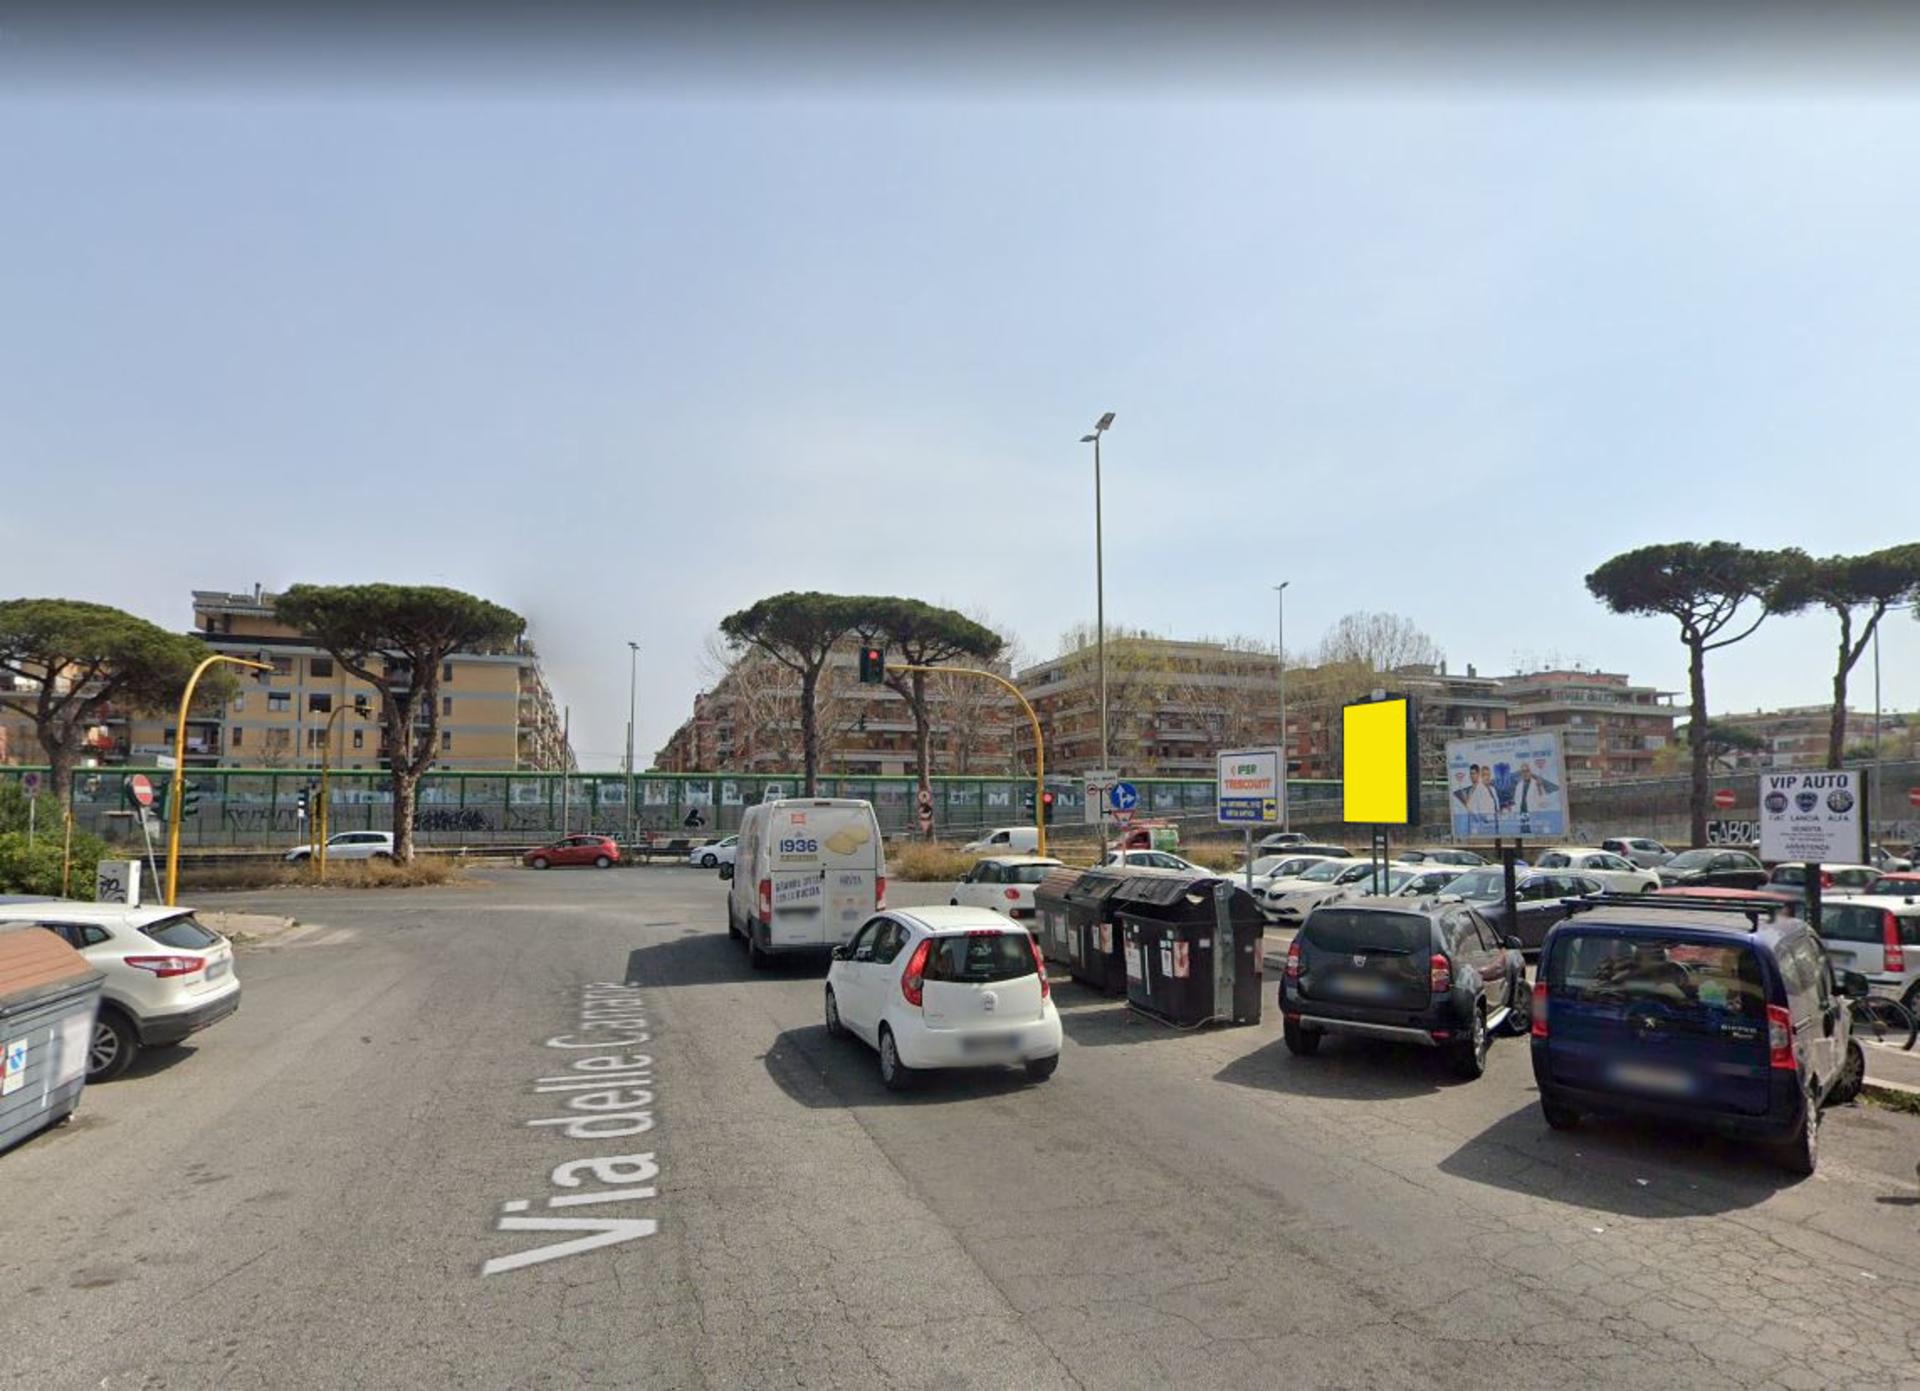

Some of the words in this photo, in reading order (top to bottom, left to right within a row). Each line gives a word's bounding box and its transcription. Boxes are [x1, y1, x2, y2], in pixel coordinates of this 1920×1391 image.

[1770, 777, 1797, 789] VIP
[1802, 774, 1848, 788] AUTO
[780, 839, 818, 853] 1936
